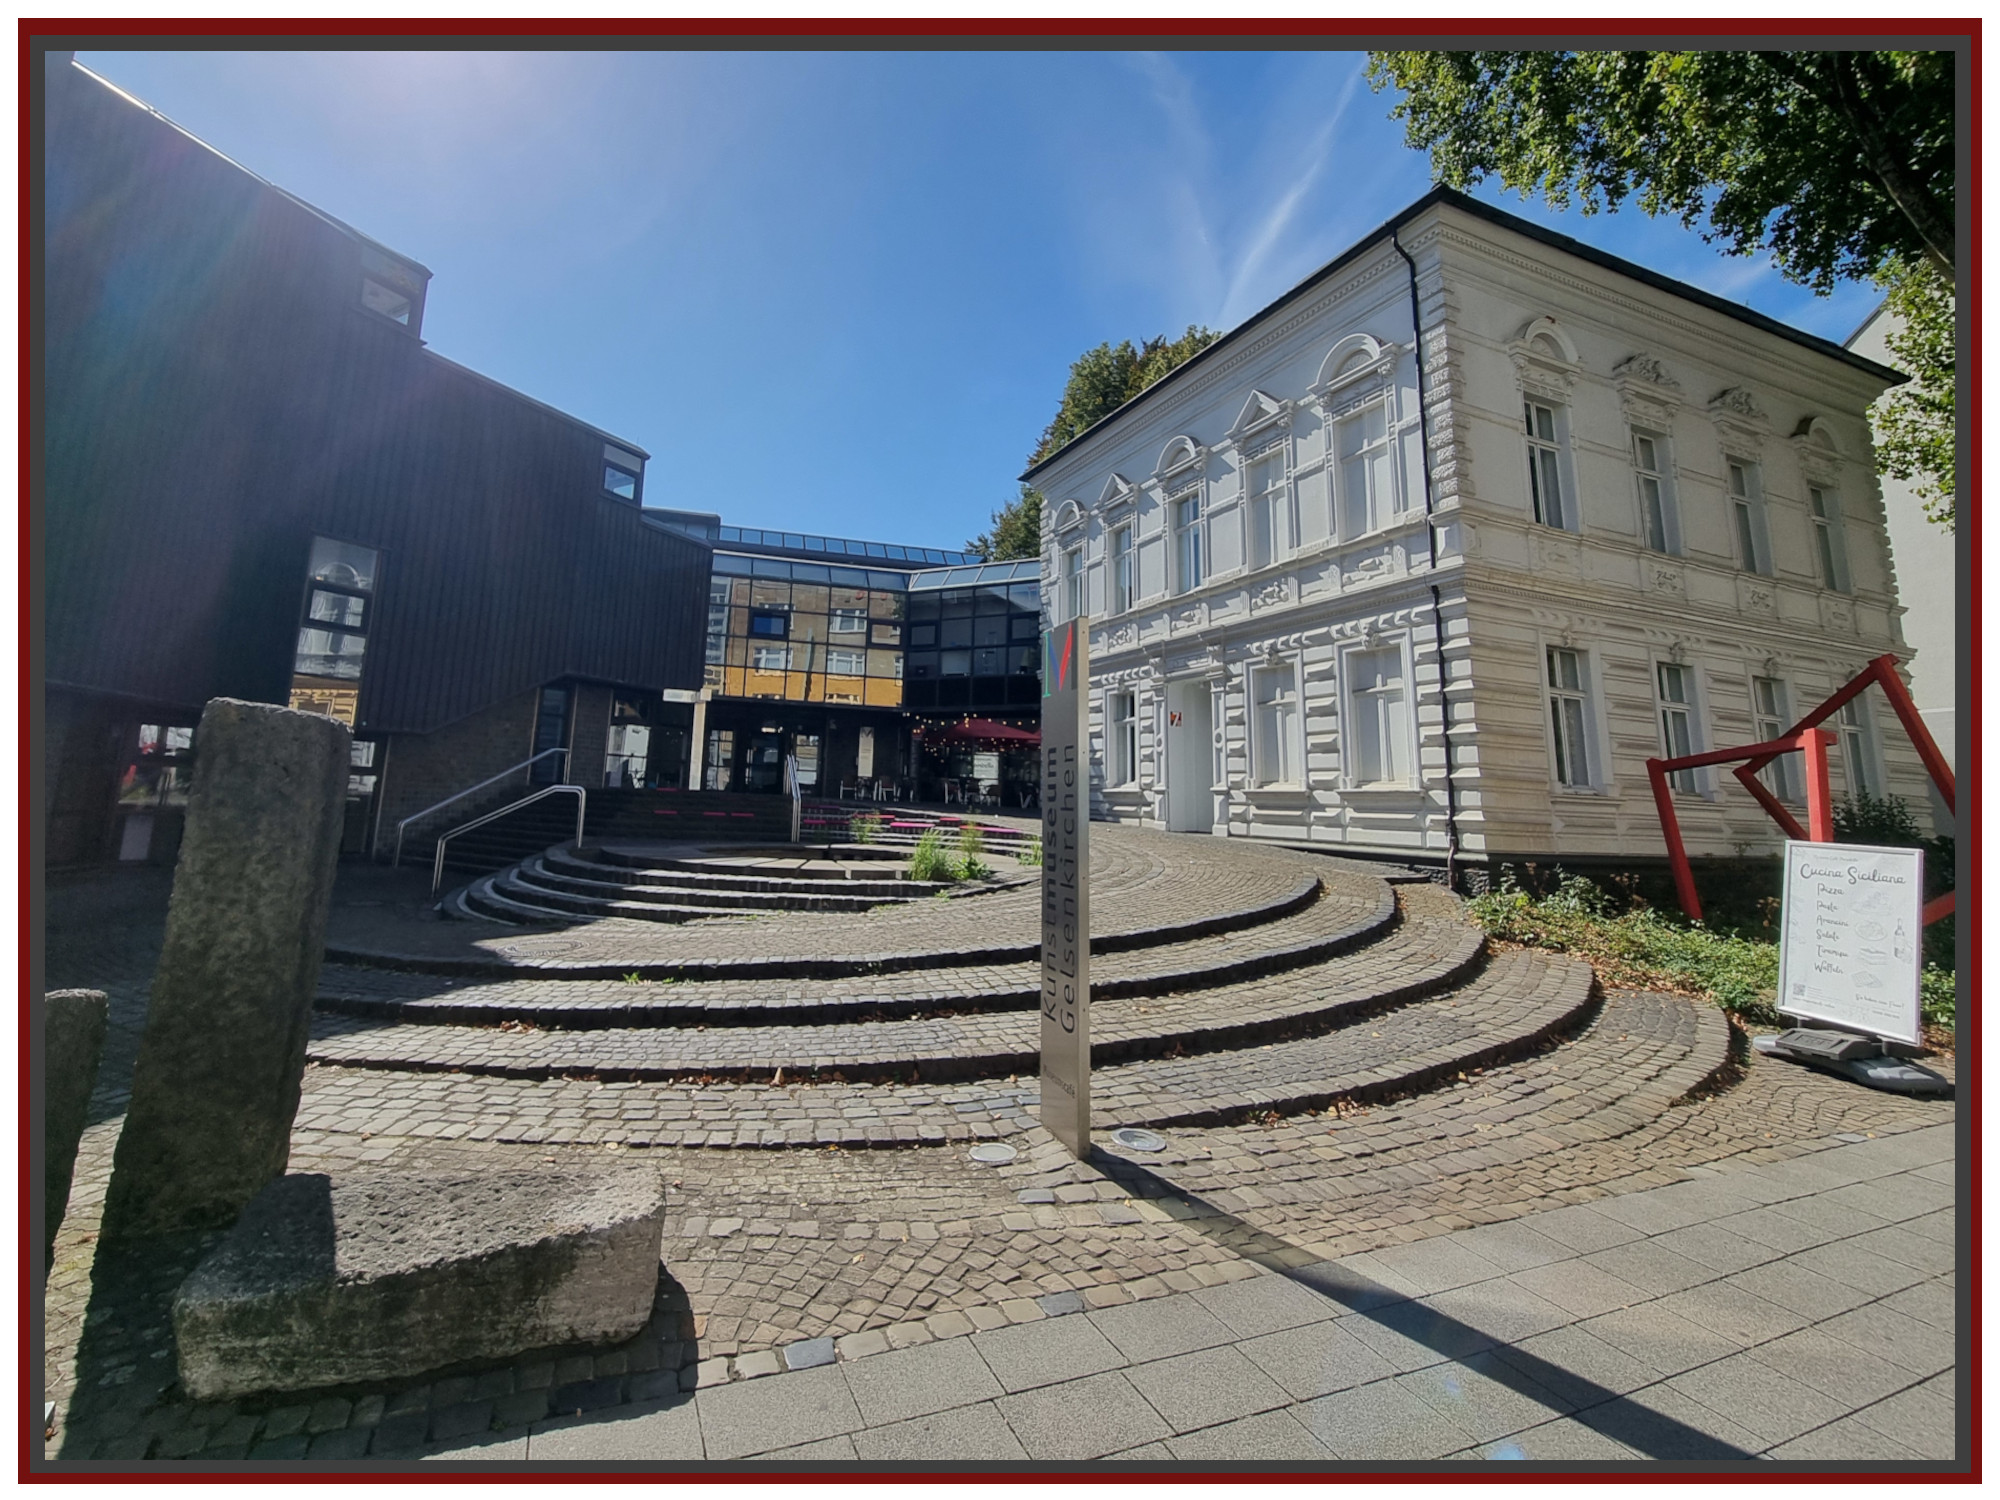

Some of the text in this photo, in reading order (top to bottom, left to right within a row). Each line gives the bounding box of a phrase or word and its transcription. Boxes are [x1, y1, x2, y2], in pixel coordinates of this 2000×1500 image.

[1042, 621, 1077, 697] M
[1044, 747, 1057, 1022] Kunstmuseum
[1800, 863, 1906, 885] Cucina Siciliana
[1060, 745, 1075, 1033] Gelsenkirchen
[1817, 882, 1845, 896] Pizza
[1816, 900, 1838, 912] Pasta
[1816, 914, 1849, 927] Arancini
